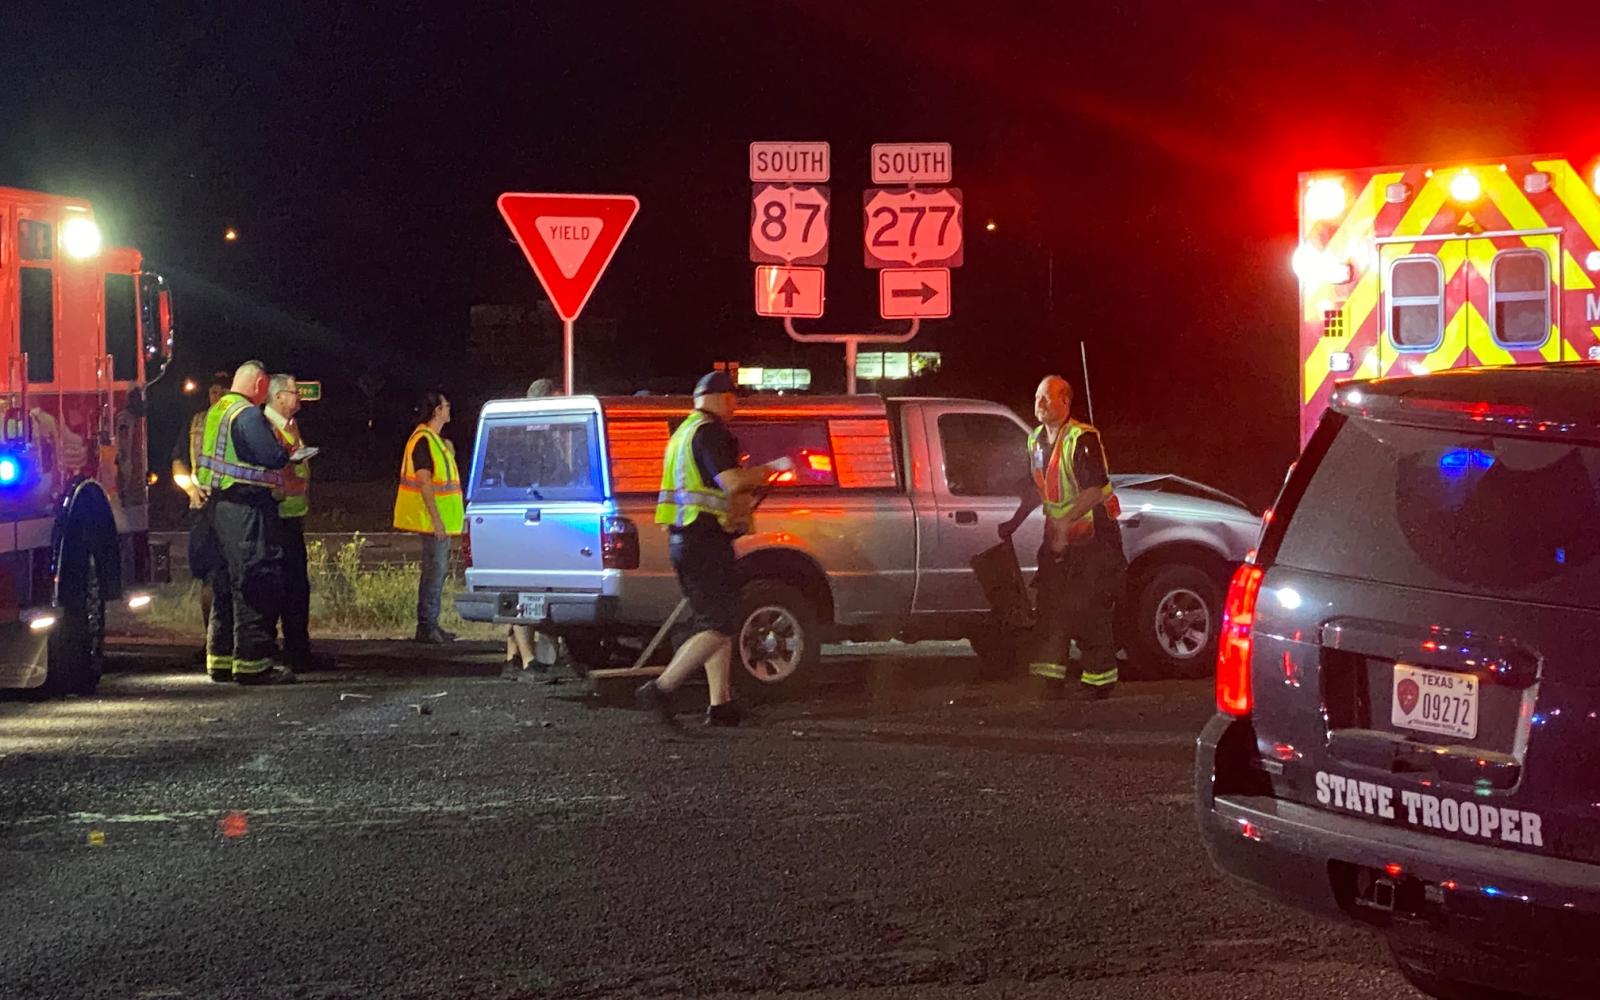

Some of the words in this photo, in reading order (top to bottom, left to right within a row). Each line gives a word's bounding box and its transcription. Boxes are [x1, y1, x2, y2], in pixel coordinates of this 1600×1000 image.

[756, 151, 824, 173] SOUTH
[878, 152, 946, 175] SOUTH
[550, 225, 590, 241] YIELD
[760, 200, 821, 244] 87
[872, 206, 956, 247] 277
[1421, 673, 1454, 689] TEXAS
[1422, 693, 1470, 726] 09272
[1315, 771, 1395, 820] STATE
[1402, 790, 1544, 847] TROOPER
